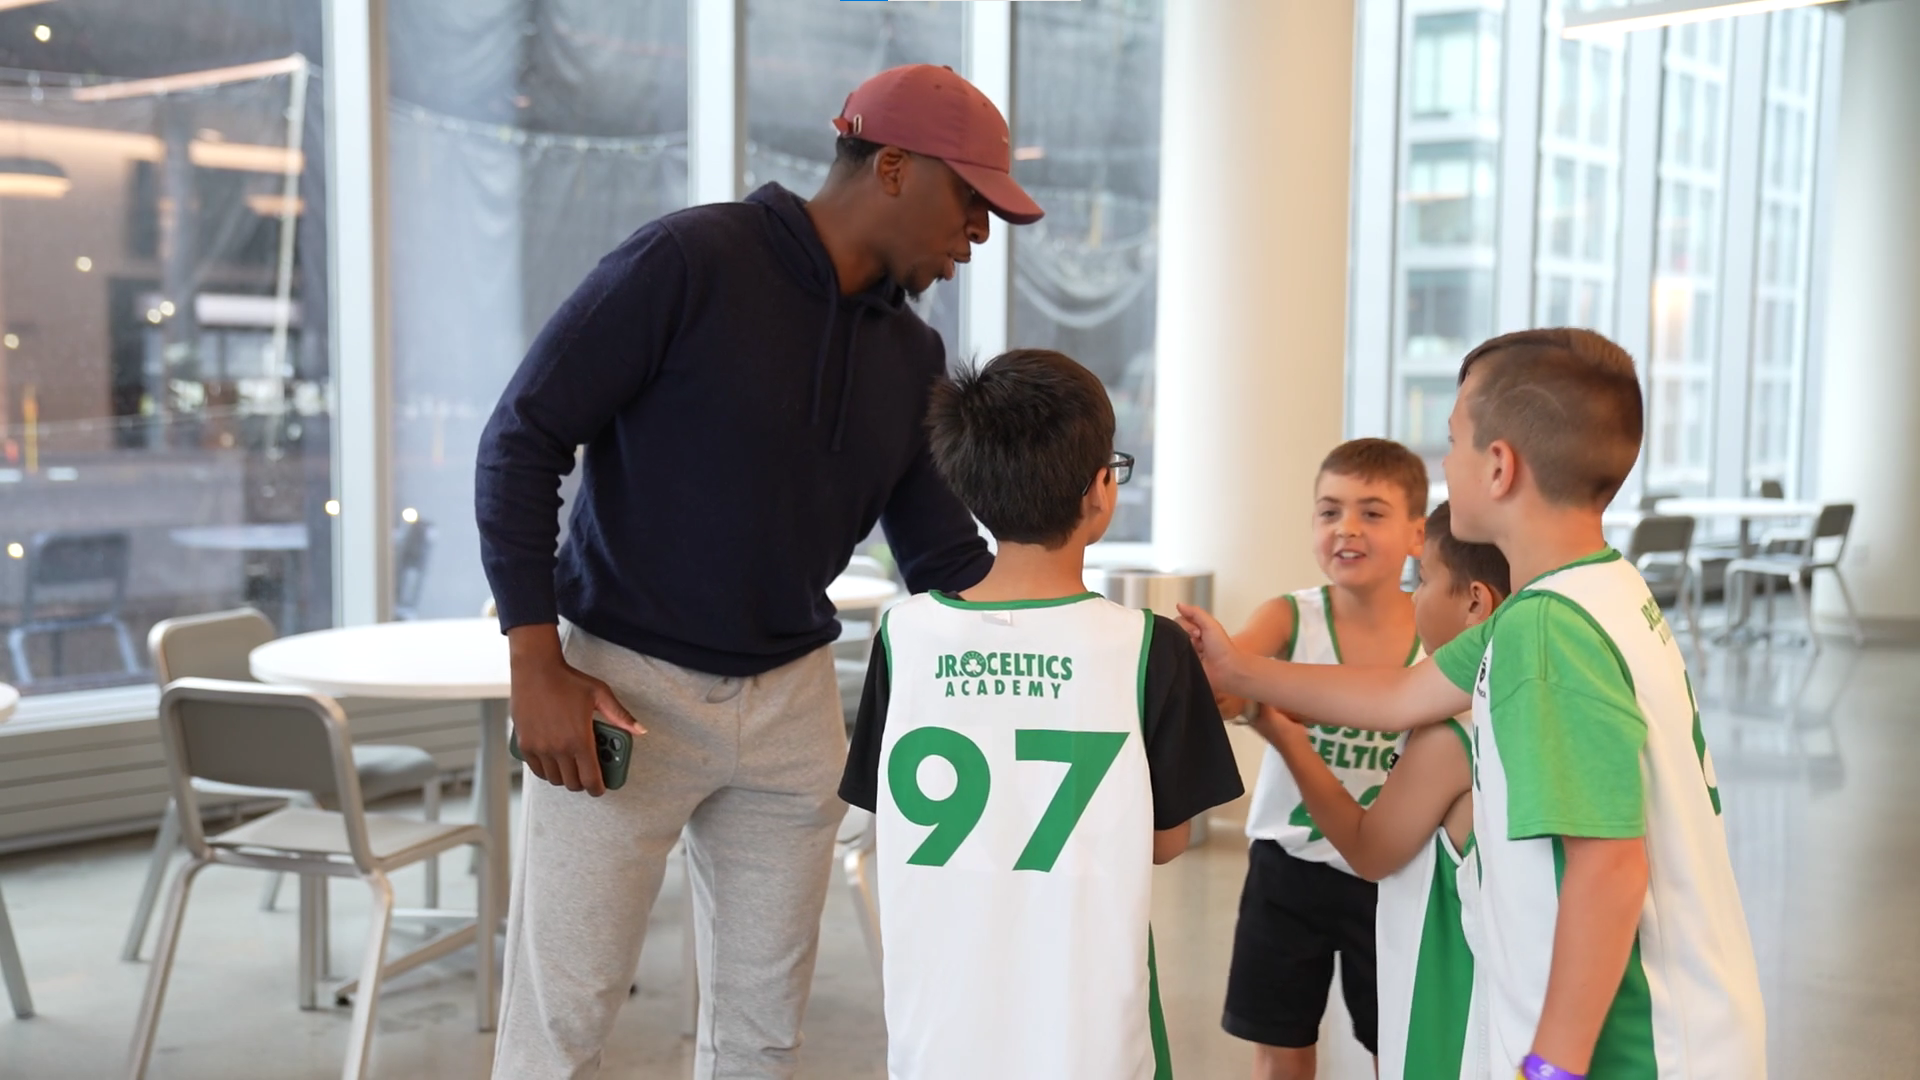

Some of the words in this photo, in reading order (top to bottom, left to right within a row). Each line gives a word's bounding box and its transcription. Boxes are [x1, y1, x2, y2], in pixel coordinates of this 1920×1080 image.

[986, 652, 1073, 681] CELTICS
[945, 679, 1061, 699] ACADEMY
[1308, 736, 1395, 773] ELTIC
[887, 726, 1131, 872] 97
